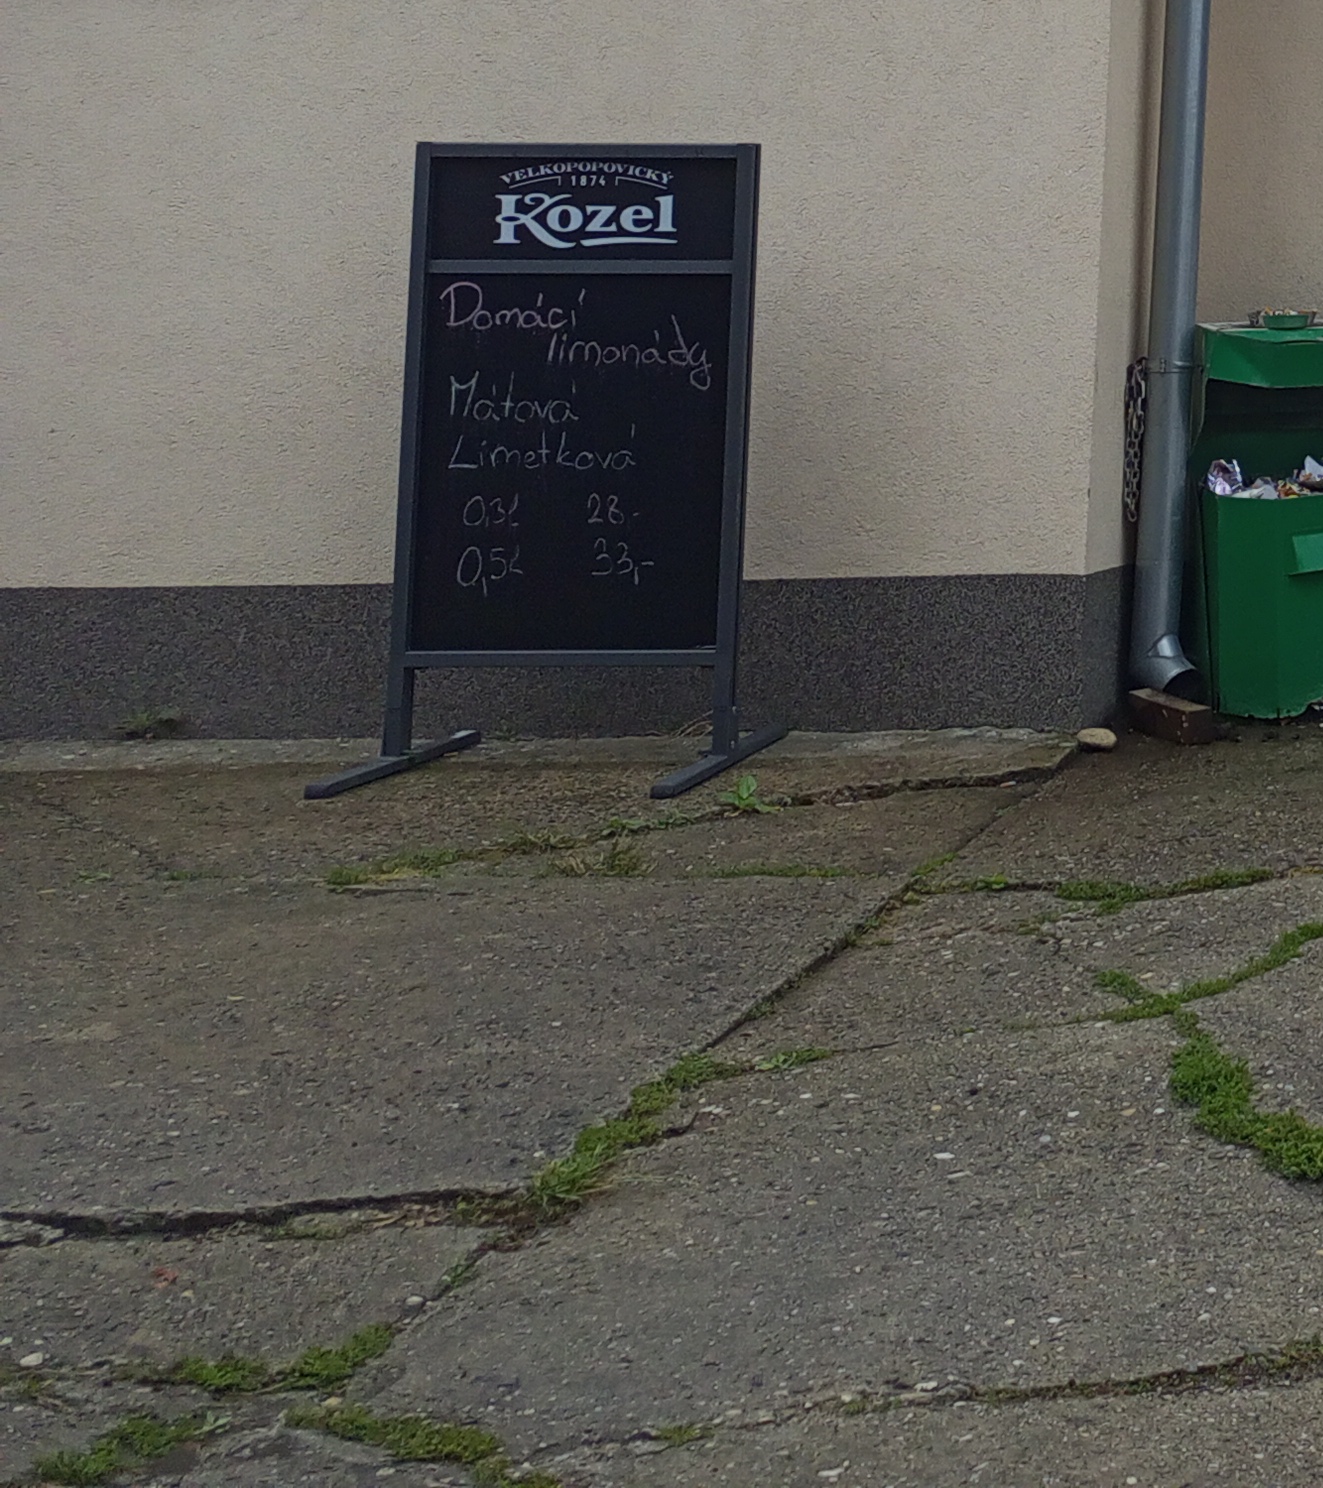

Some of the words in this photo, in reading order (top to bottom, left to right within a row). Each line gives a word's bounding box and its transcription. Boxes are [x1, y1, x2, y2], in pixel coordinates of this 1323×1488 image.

[500, 161, 675, 185] VELKOPOPOVICKÝ
[570, 175, 606, 187] 1874
[493, 192, 679, 249] Kozel
[547, 313, 712, 391] limonády
[449, 370, 579, 424] Mátová
[447, 423, 637, 470] Limetková
